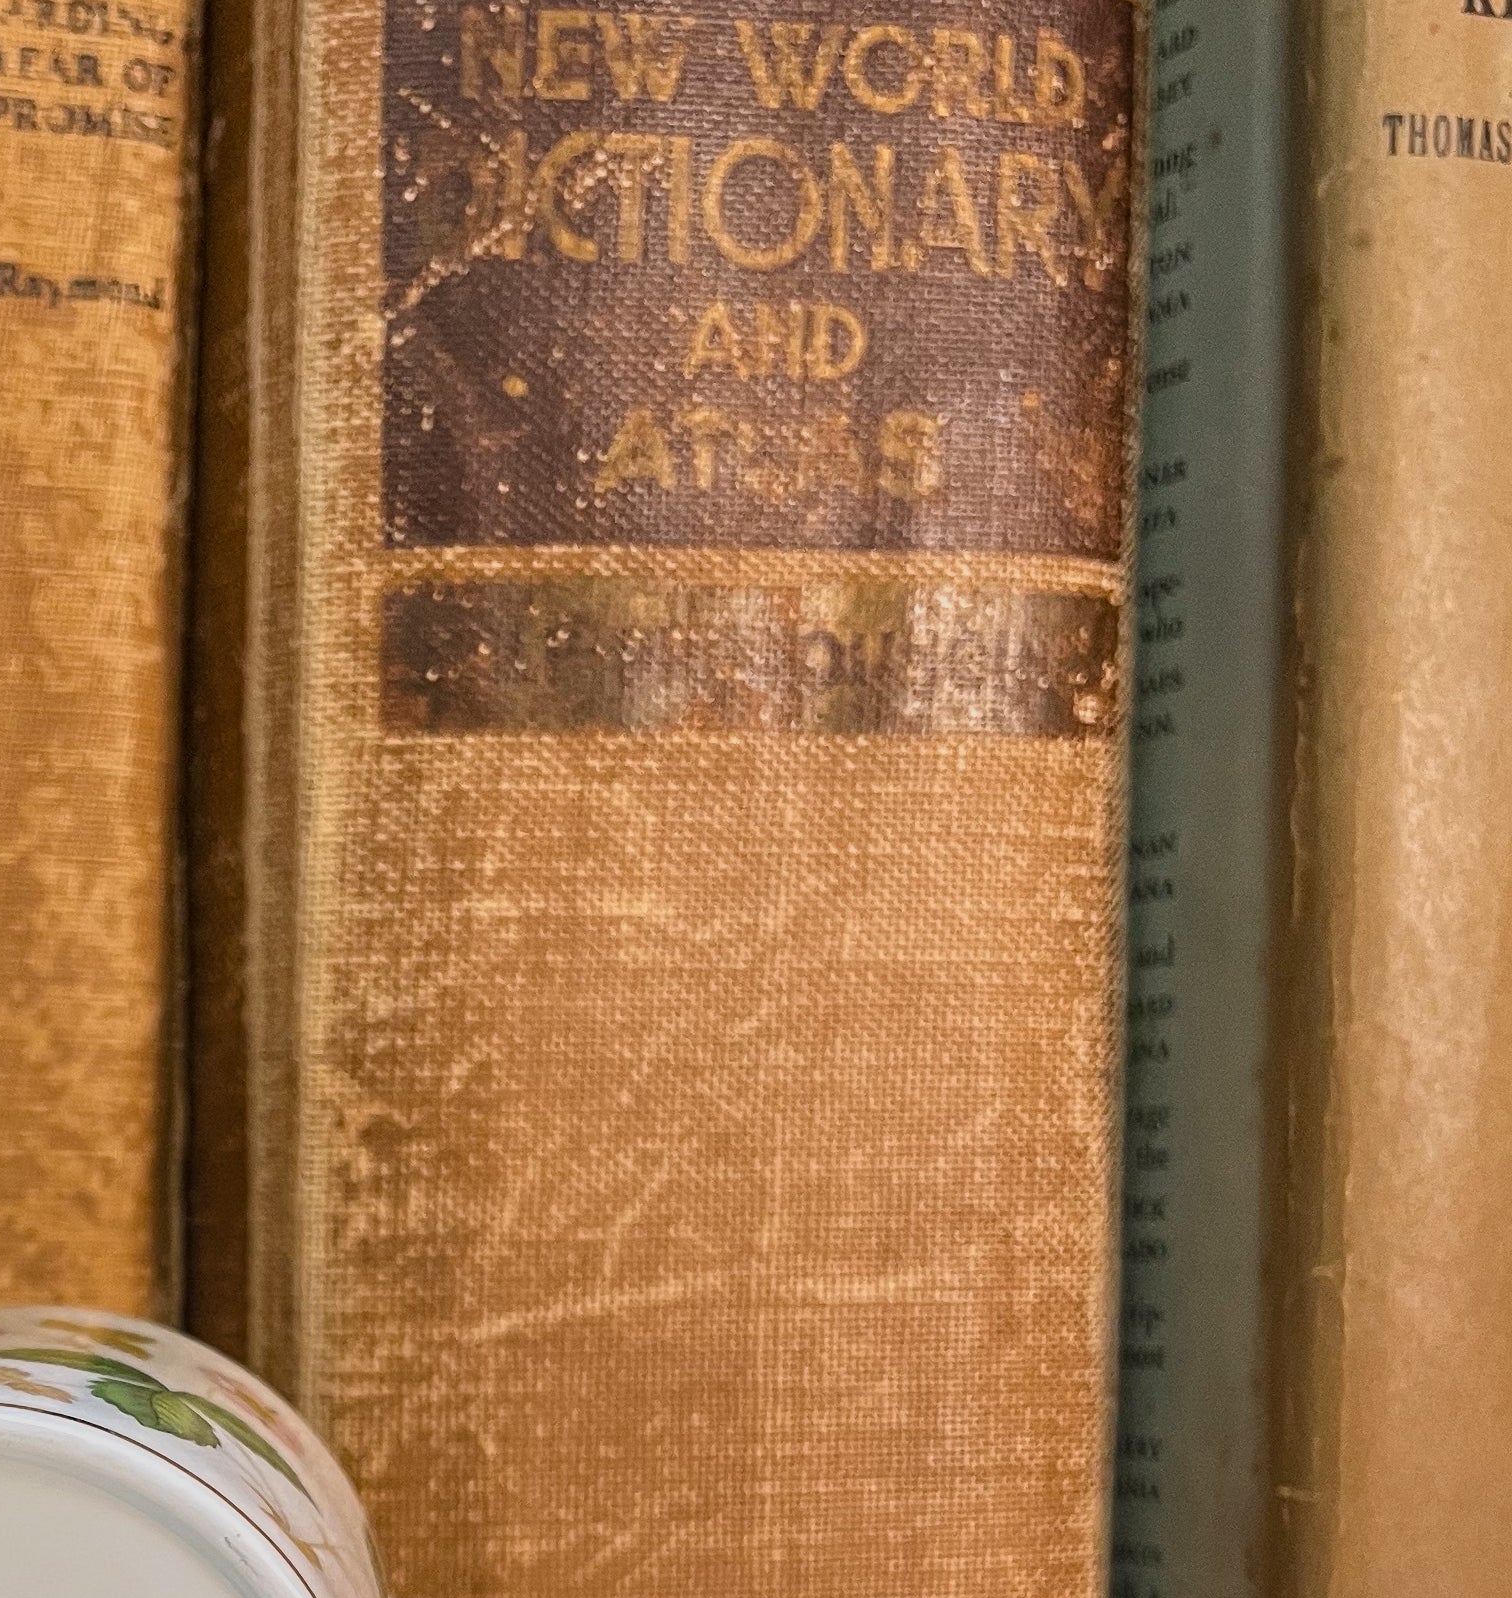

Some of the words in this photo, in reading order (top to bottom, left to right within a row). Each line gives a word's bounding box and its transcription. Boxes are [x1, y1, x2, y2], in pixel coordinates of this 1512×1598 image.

[456, 6, 694, 103] NEW
[734, 23, 1088, 127] WORLD
[1383, 112, 1512, 165] THOMAS
[420, 129, 1130, 288] ICTIONARY
[685, 302, 870, 382] AND
[592, 405, 946, 500] ATS
